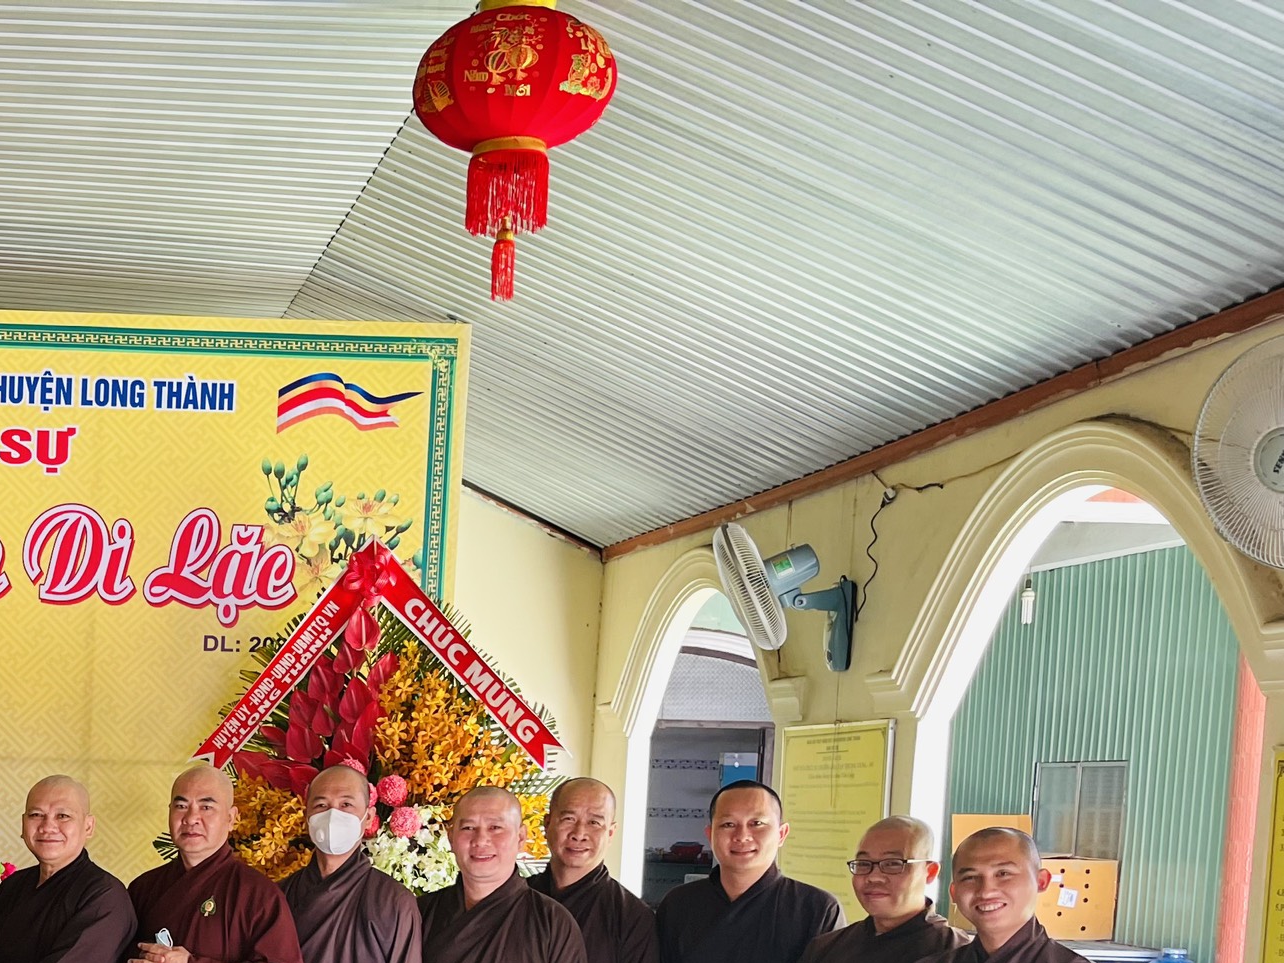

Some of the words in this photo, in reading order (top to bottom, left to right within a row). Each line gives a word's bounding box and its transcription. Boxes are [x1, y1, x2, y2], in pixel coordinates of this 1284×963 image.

[80, 378, 145, 409] LONG
[153, 375, 235, 411] THÀNH
[0, 427, 77, 474] SỰ
[22, 503, 137, 606] Di
[143, 507, 298, 628] Lặc
[203, 635, 241, 653] DL:
[281, 627, 333, 684] THÀNH
[404, 597, 469, 666] CHÚC
[463, 659, 540, 744] MỪNG
[212, 718, 242, 750] HUYỆN
[321, 600, 341, 618] VN
